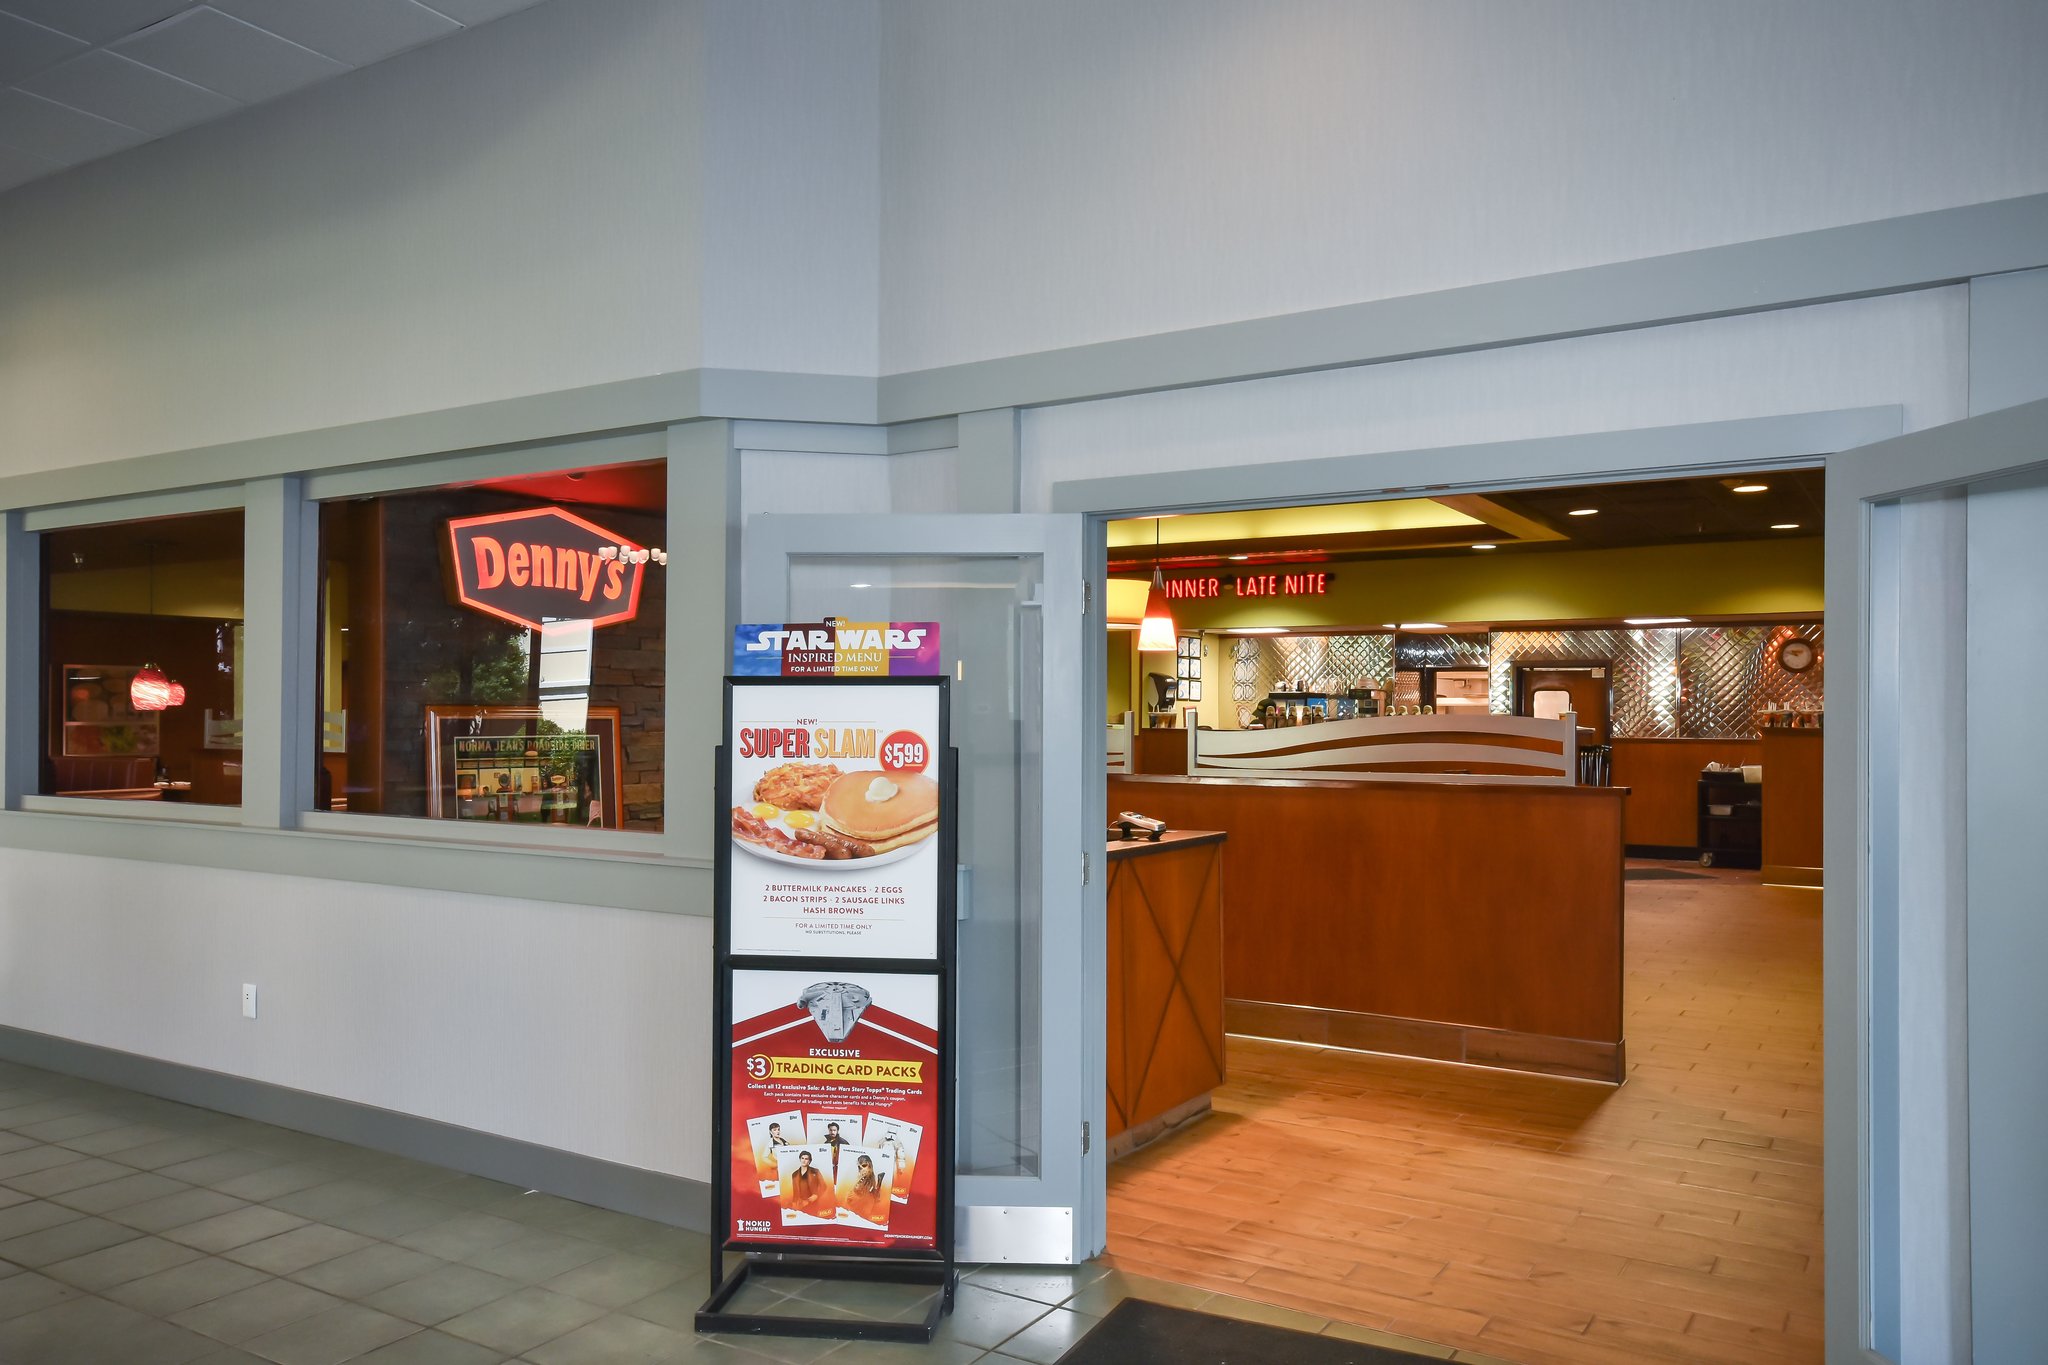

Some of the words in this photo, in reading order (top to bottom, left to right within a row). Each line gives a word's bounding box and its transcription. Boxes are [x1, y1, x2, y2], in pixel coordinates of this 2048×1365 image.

[471, 536, 625, 602] Denny's
[1166, 578, 1218, 598] INNER
[1236, 576, 1276, 596] LATE
[1285, 574, 1326, 594] NITE
[746, 630, 834, 650] STAR
[788, 653, 844, 663] INSPIRED
[846, 653, 882, 662] MENU
[460, 741, 492, 751] NORMA
[740, 728, 810, 758] SUPER
[809, 1048, 860, 1057] EXCLUSIVE
[747, 1058, 766, 1076] $3
[776, 1062, 833, 1075] TRADING
[837, 1064, 873, 1076] CARD
[876, 1066, 916, 1077] PACKS
